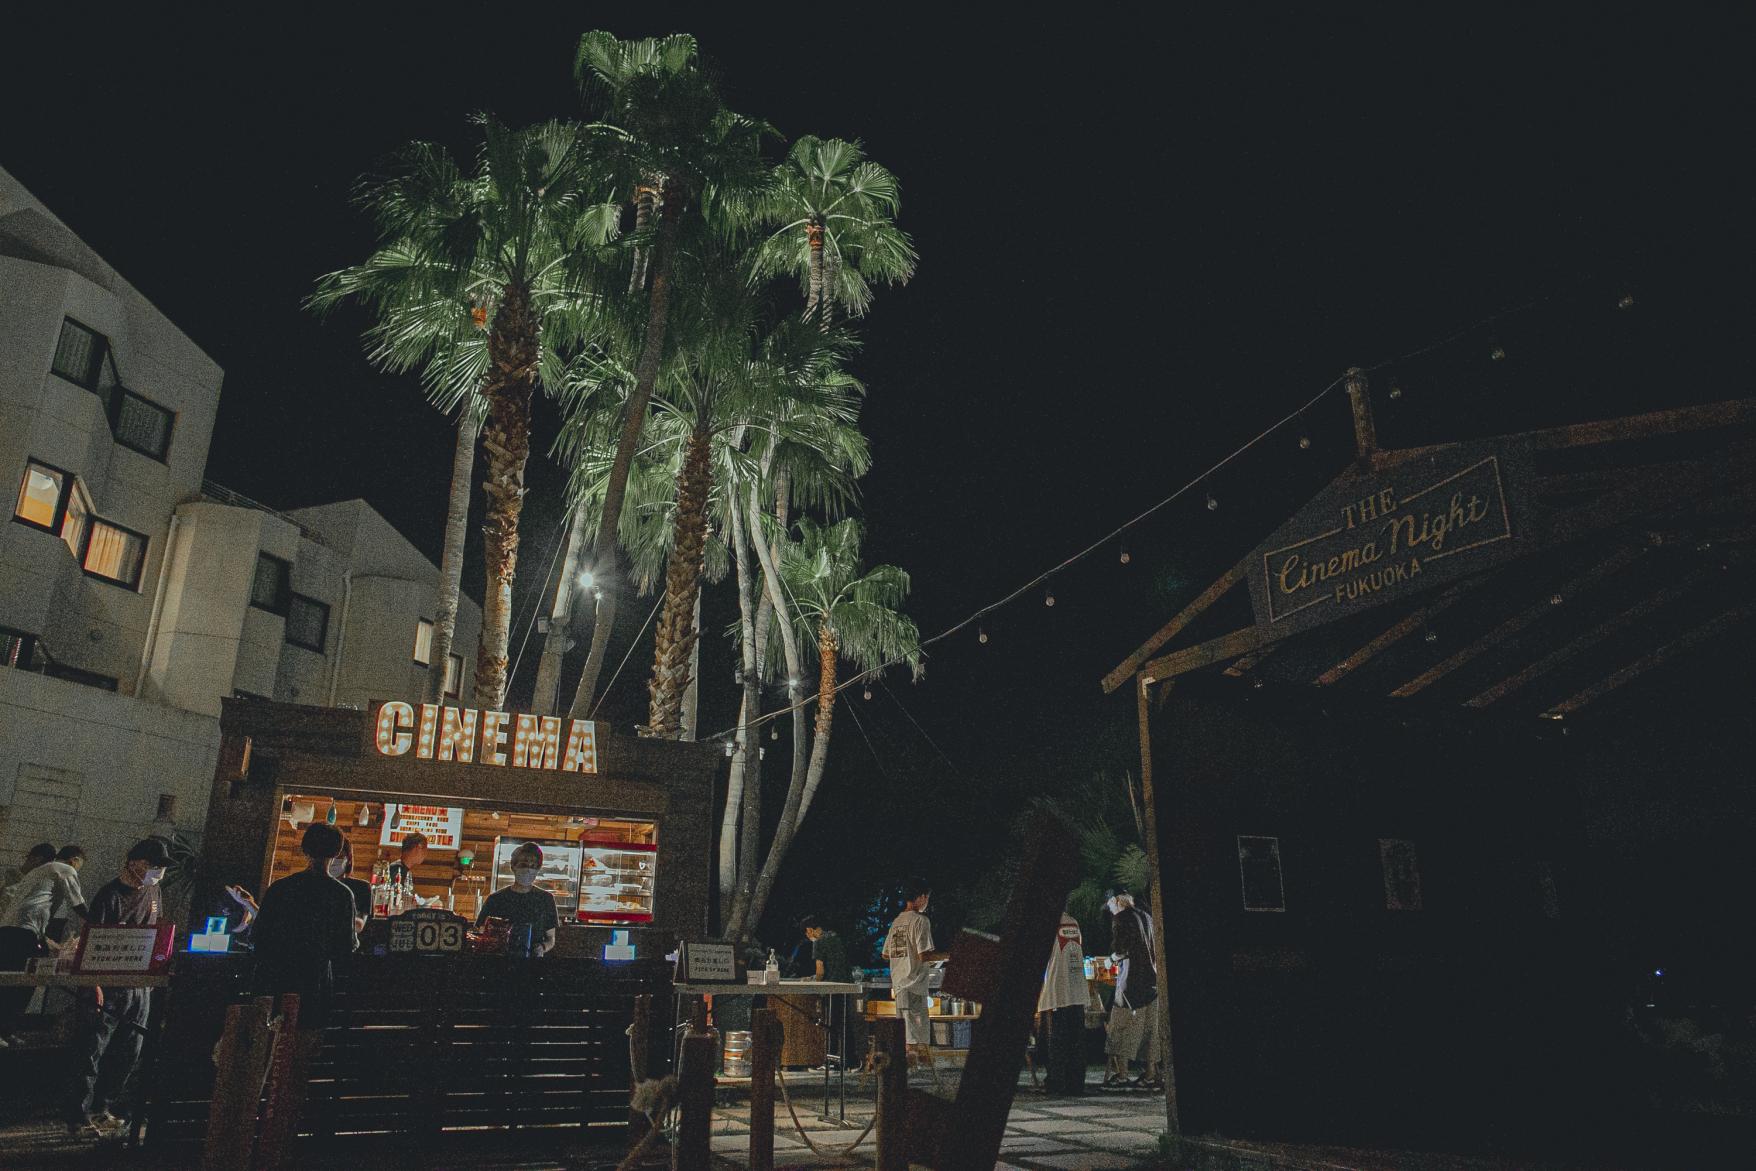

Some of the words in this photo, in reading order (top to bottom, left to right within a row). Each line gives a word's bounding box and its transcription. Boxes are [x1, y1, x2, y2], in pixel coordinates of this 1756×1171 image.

[1340, 487, 1398, 529] THE
[1273, 542, 1384, 594] Cinema
[1378, 491, 1490, 553] Night
[1335, 557, 1423, 604] FUKUOKA
[376, 701, 598, 774] CINEMA
[411, 805, 438, 816] MENU
